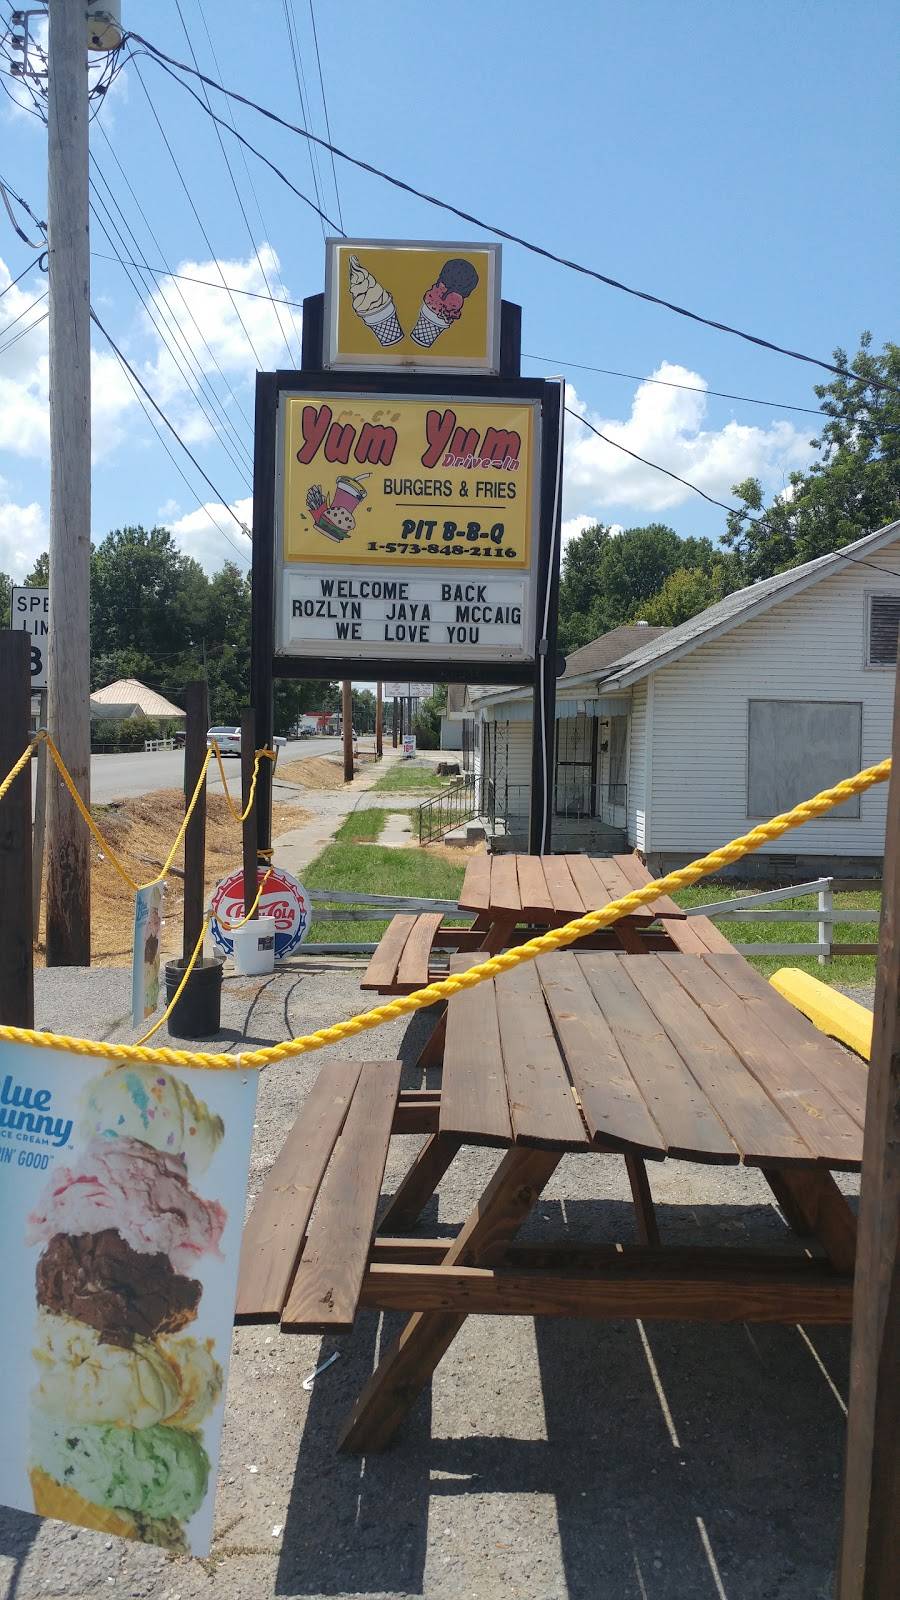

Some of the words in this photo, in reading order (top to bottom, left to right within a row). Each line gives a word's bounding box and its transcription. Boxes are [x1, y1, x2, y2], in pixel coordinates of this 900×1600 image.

[297, 405, 398, 466] Yum
[421, 409, 521, 469] Yum
[441, 452, 521, 471] Drive-In
[383, 478, 453, 497] BURGERS
[459, 481, 469, 497] &
[475, 481, 516, 499] FRIES
[401, 519, 437, 540] PIT
[442, 521, 505, 544] B-B-Q
[367, 541, 517, 558] 1-573-848-2116
[320, 579, 409, 600] WELCOME
[441, 583, 487, 602] BACK
[17, 596, 49, 612] SPE
[292, 600, 361, 619] ROZLYN
[385, 604, 431, 621] JAYA
[455, 606, 521, 624] MCCAIG
[336, 622, 362, 640] WE
[385, 624, 430, 643] LOVE
[447, 626, 480, 644] YOU
[0, 1075, 52, 1111] lue
[0, 1108, 73, 1147] unny
[1, 1130, 12, 1139] CE
[16, 1133, 49, 1145] CREAM
[18, 1150, 49, 1170] GOOD
